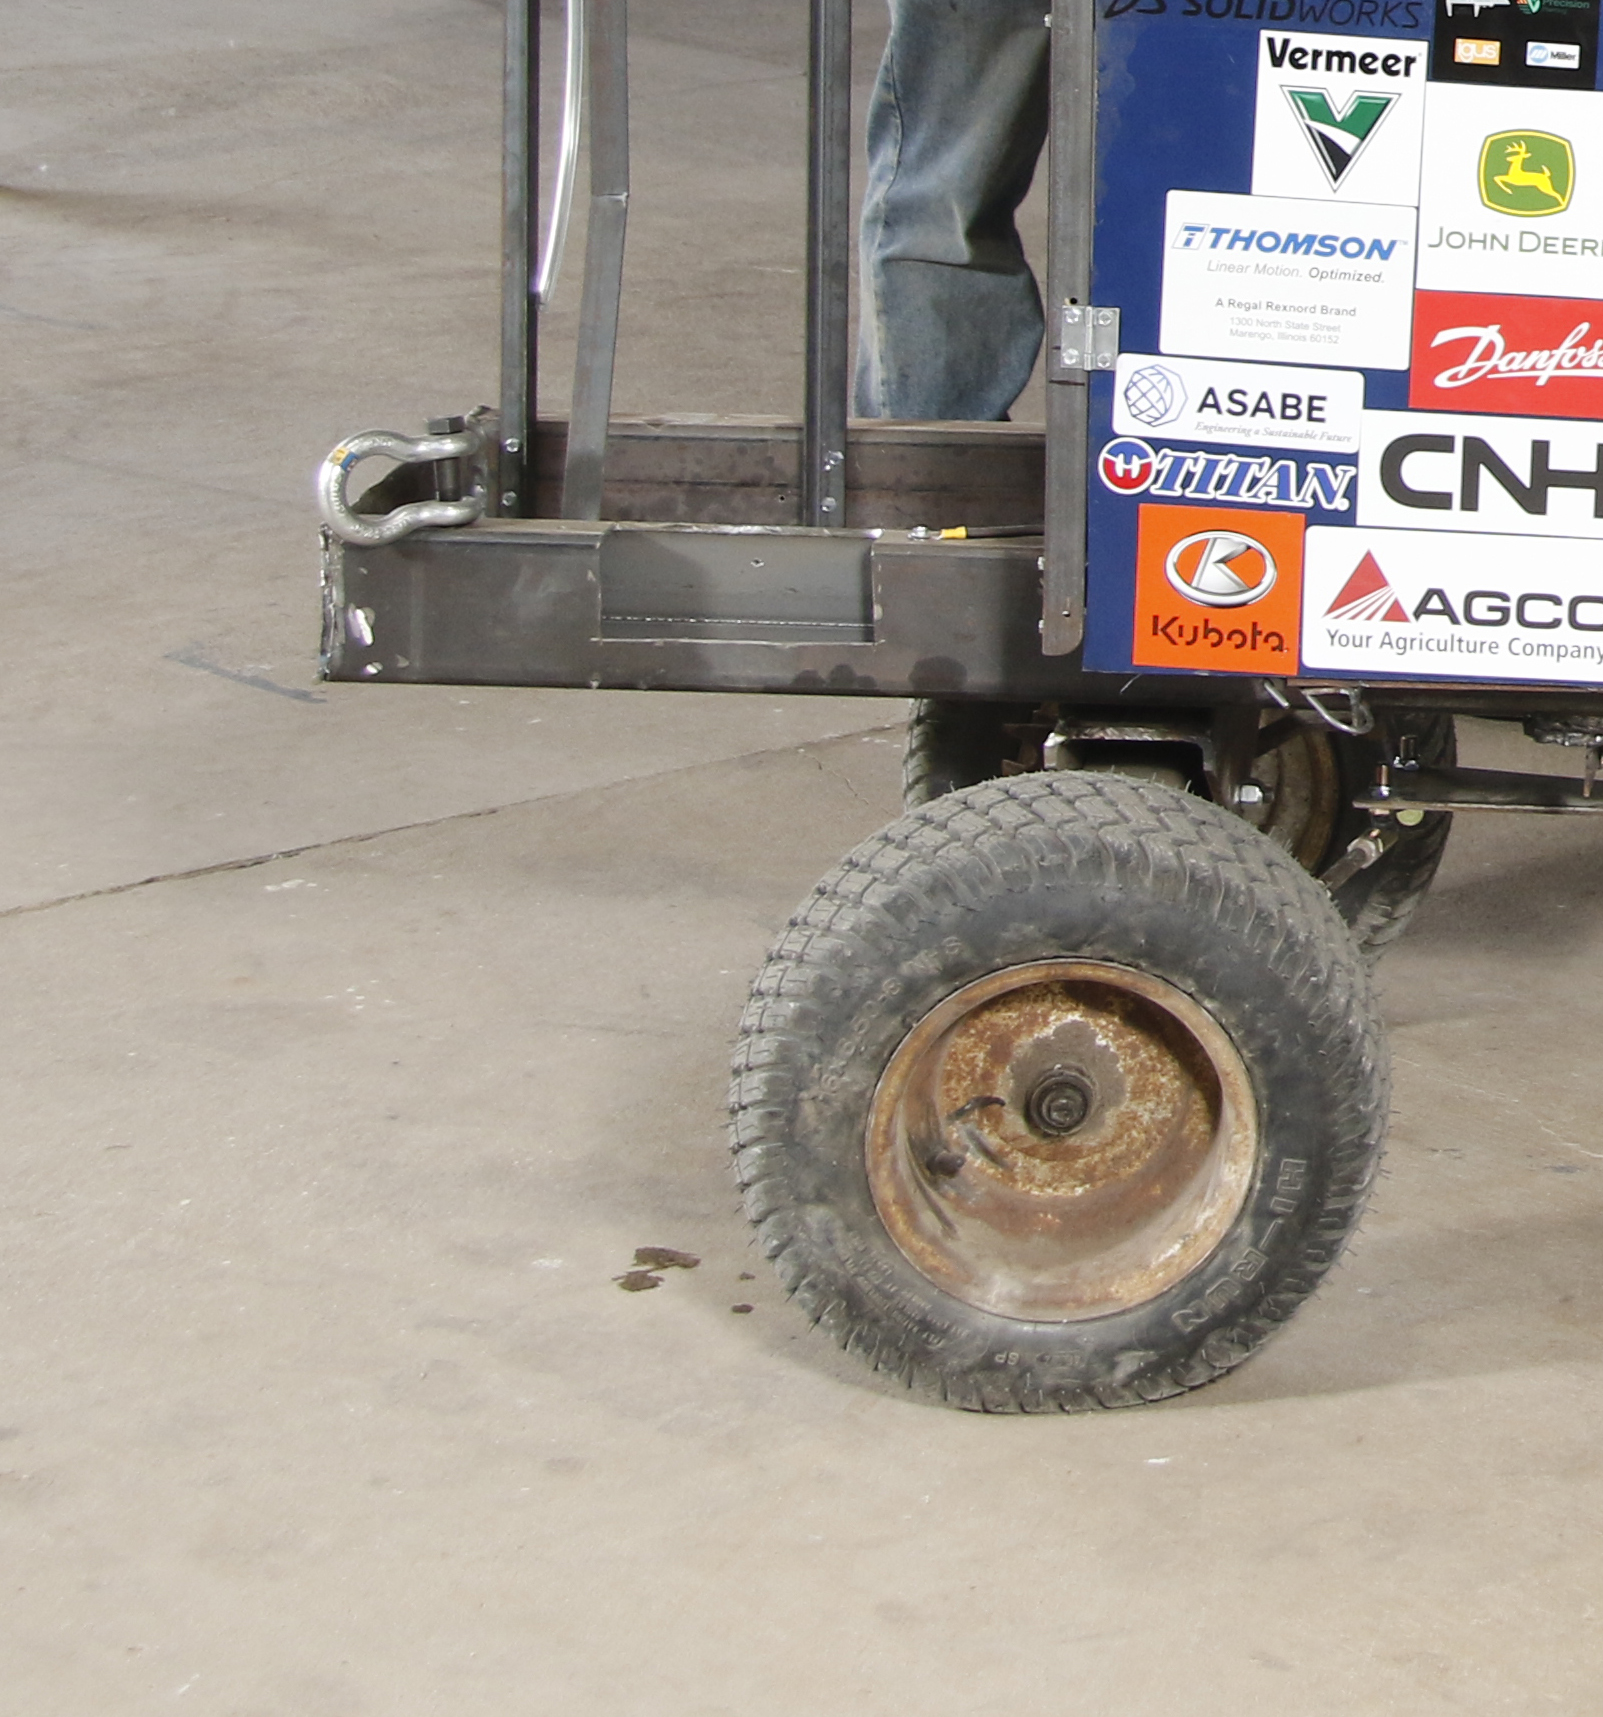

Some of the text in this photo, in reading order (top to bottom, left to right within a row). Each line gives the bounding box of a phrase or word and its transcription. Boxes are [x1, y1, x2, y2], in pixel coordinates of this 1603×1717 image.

[1267, 37, 1417, 78] Vermeer
[1457, 42, 1497, 63] igus
[1550, 51, 1576, 61] Miller
[1209, 227, 1397, 261] THOMSON
[1428, 226, 1509, 252] JOHN
[1207, 260, 1385, 283] Linear Motion. Optimized.
[1215, 298, 1357, 317] A Regal Rexnord Brand
[1230, 317, 1341, 333] 1300 North State Street
[1310, 334, 1339, 345] 60152
[1196, 386, 1328, 423] ASABE
[1195, 421, 1252, 436] Engineering
[1263, 426, 1318, 441] Sustainable
[1319, 431, 1352, 443] Future
[1151, 449, 1357, 511] TITAN
[1151, 613, 1284, 653] Kubota
[1327, 628, 1373, 650] Your
[1378, 631, 1500, 657] Agriculture
[1171, 1158, 1307, 1334] HI-RUN
